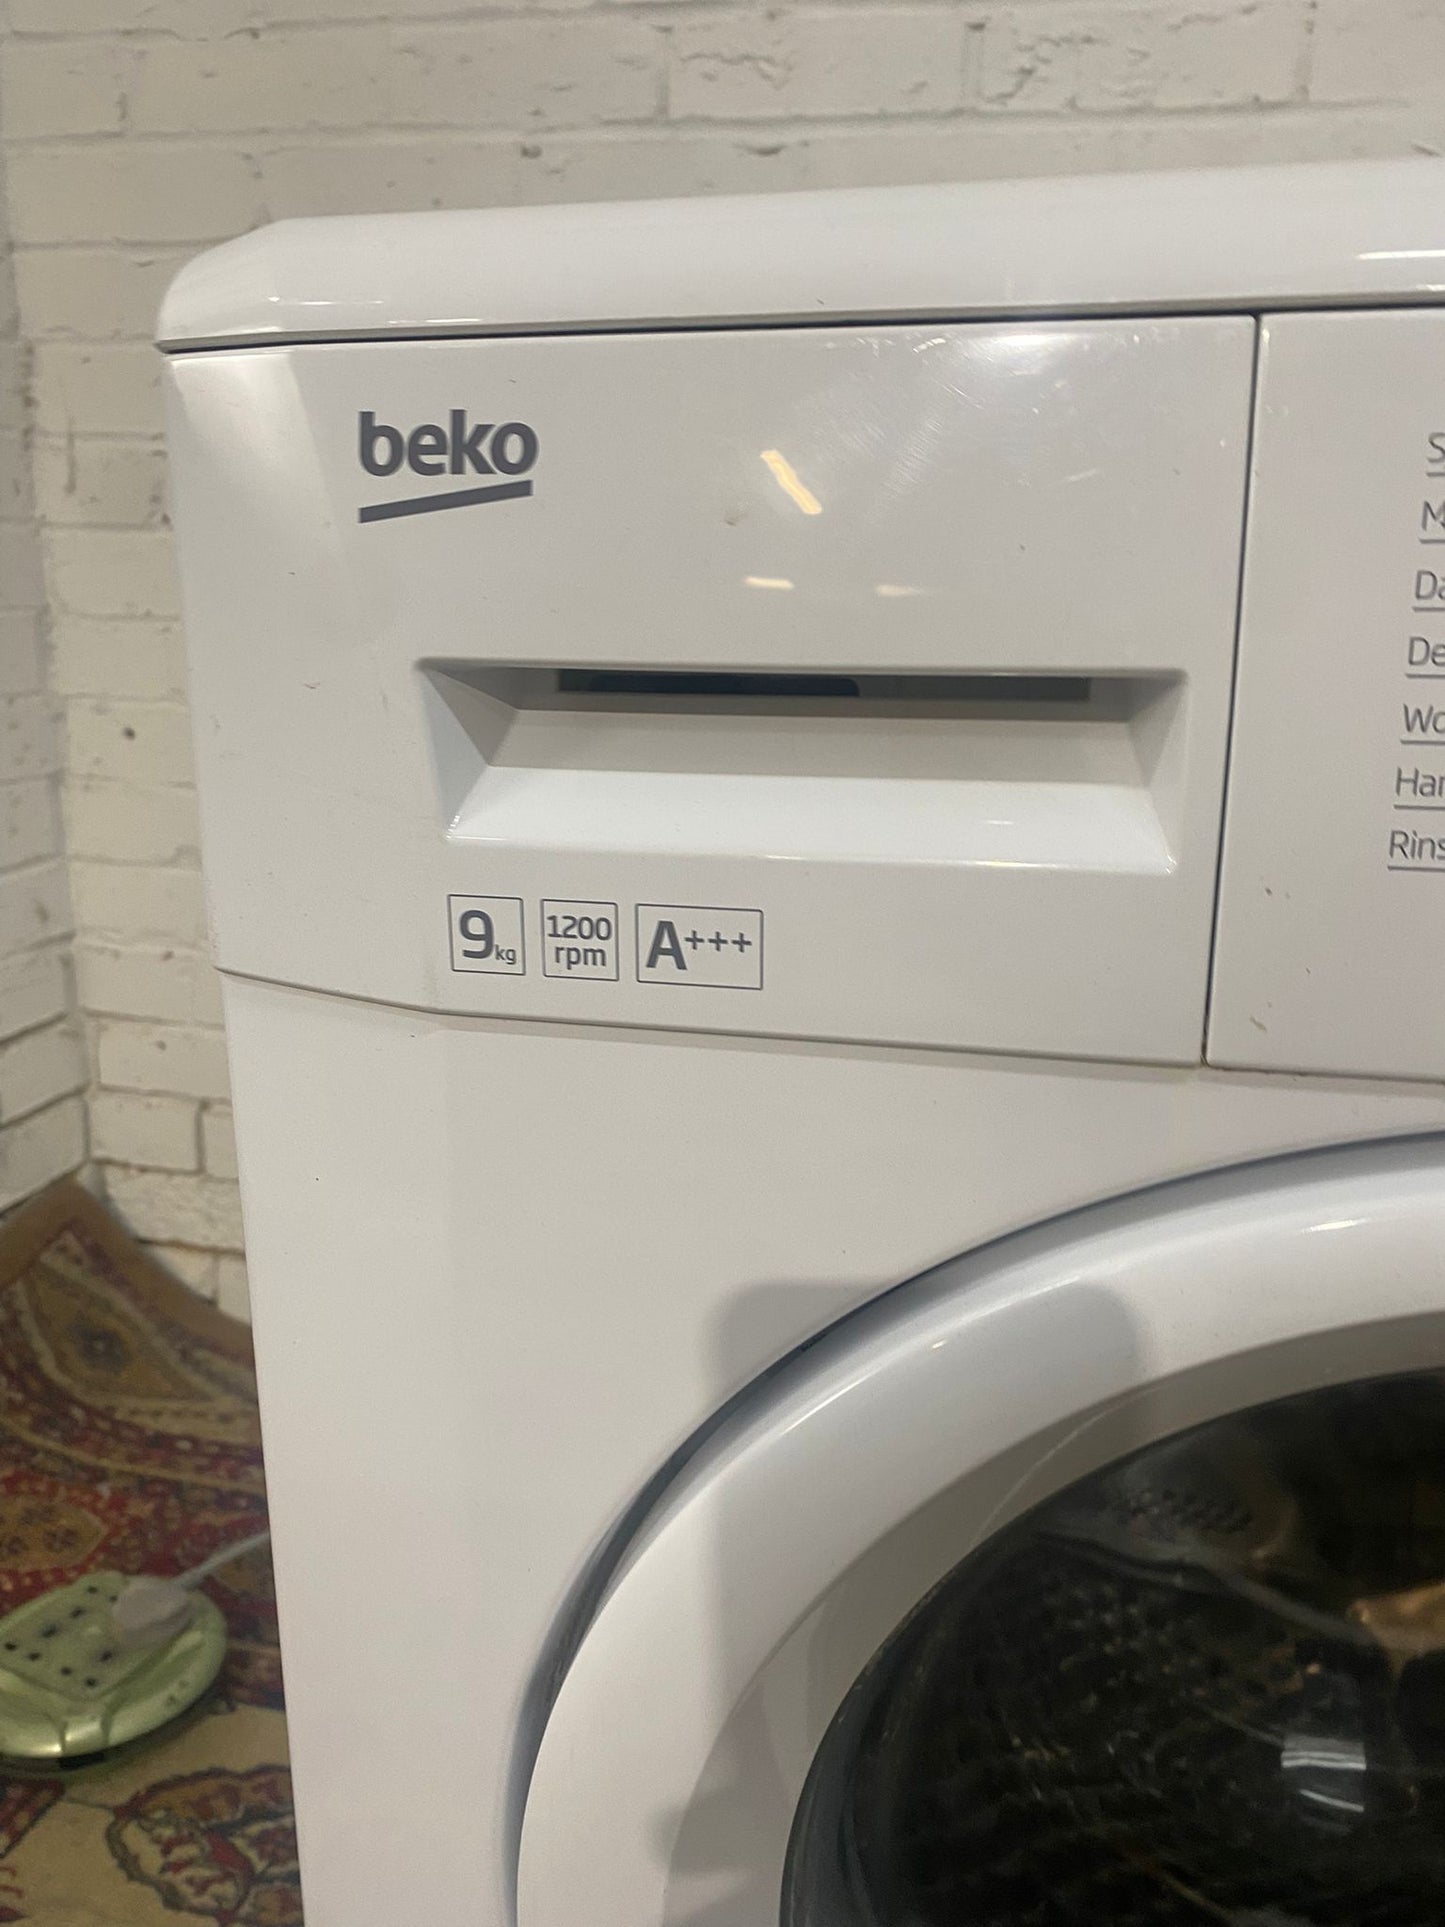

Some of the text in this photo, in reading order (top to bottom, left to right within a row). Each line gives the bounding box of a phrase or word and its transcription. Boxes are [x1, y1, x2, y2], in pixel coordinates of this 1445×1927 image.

[358, 408, 540, 477] beko
[1408, 637, 1445, 667] De
[1388, 830, 1445, 860] Rins
[547, 914, 612, 942] 1200
[554, 946, 607, 970] rpm
[645, 919, 753, 971] A+++
